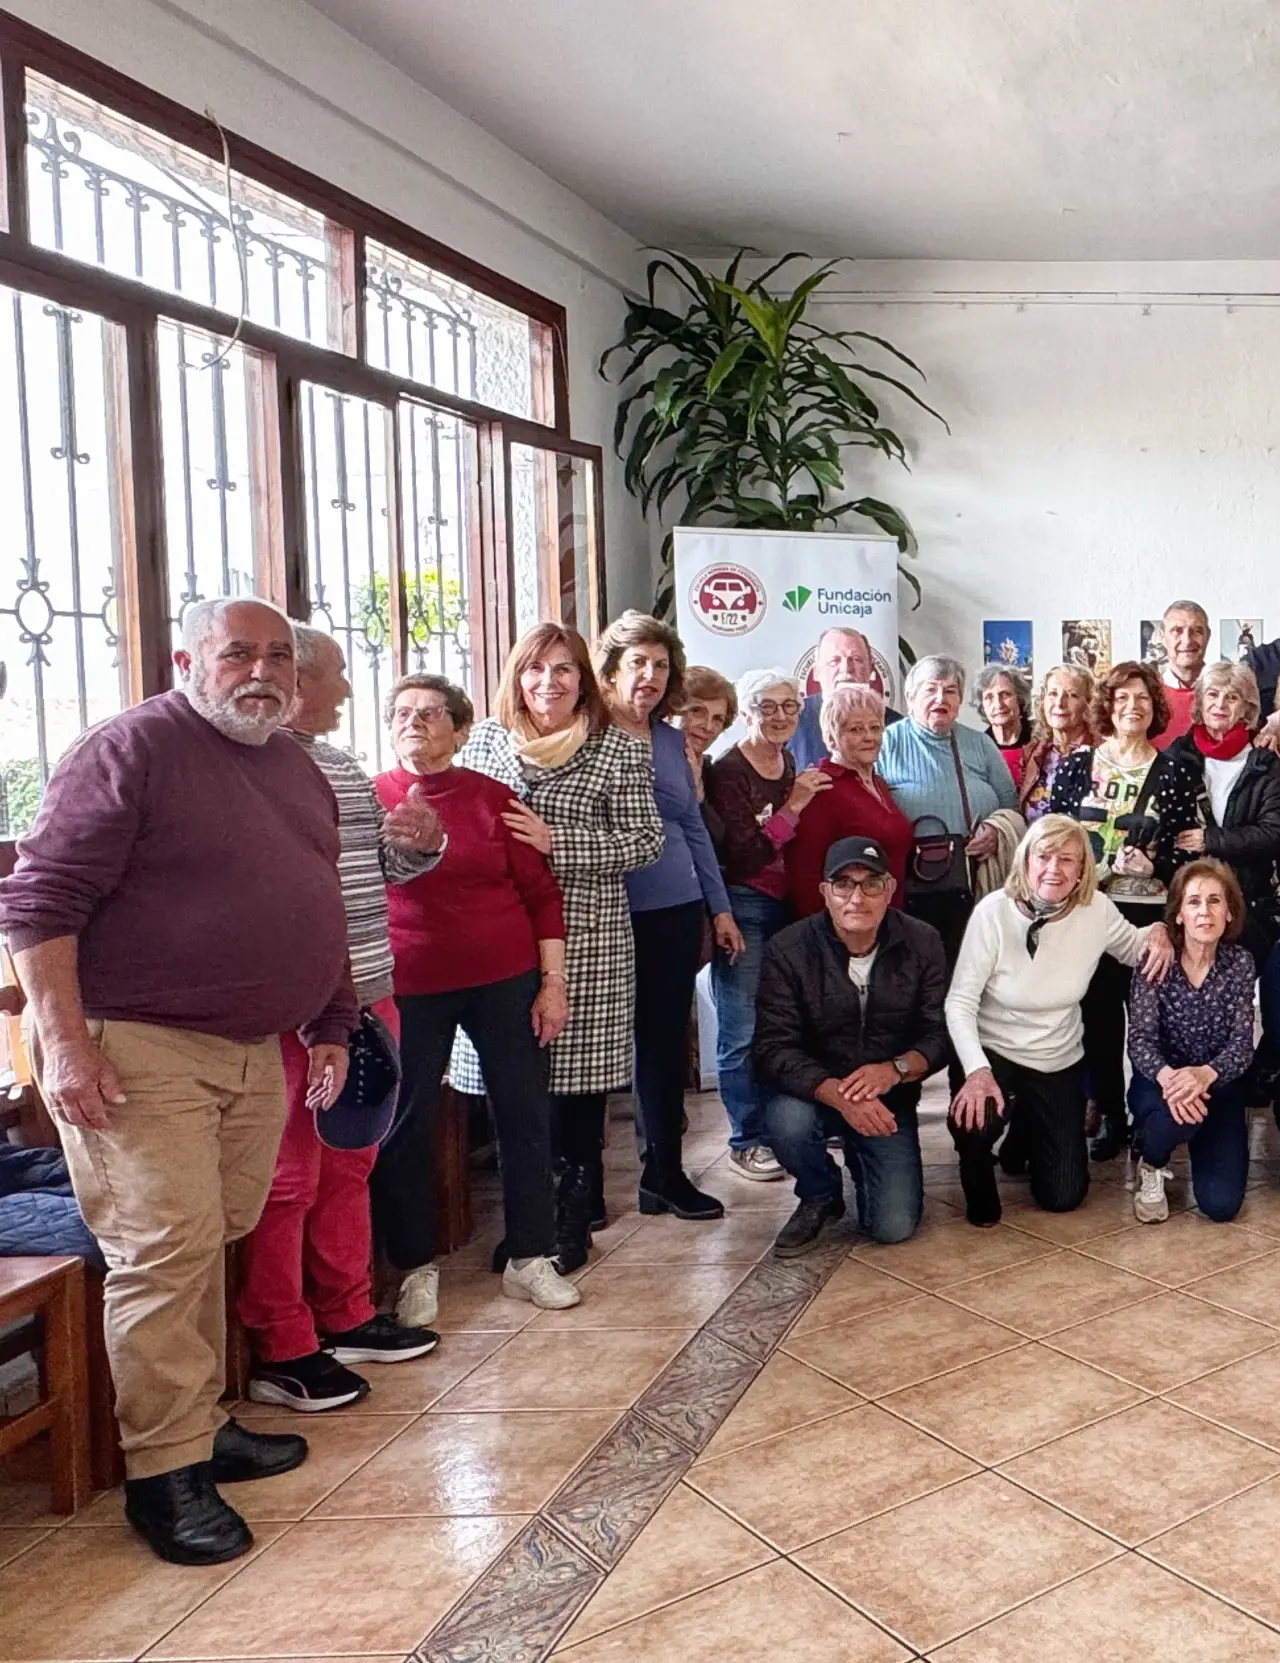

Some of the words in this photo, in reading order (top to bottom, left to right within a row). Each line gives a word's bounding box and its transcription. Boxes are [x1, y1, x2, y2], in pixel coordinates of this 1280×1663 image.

[817, 588, 892, 602] Fundación
[818, 602, 873, 618] Unicaja
[721, 612, 739, 625] F/22
[1091, 781, 1139, 802] ROP
